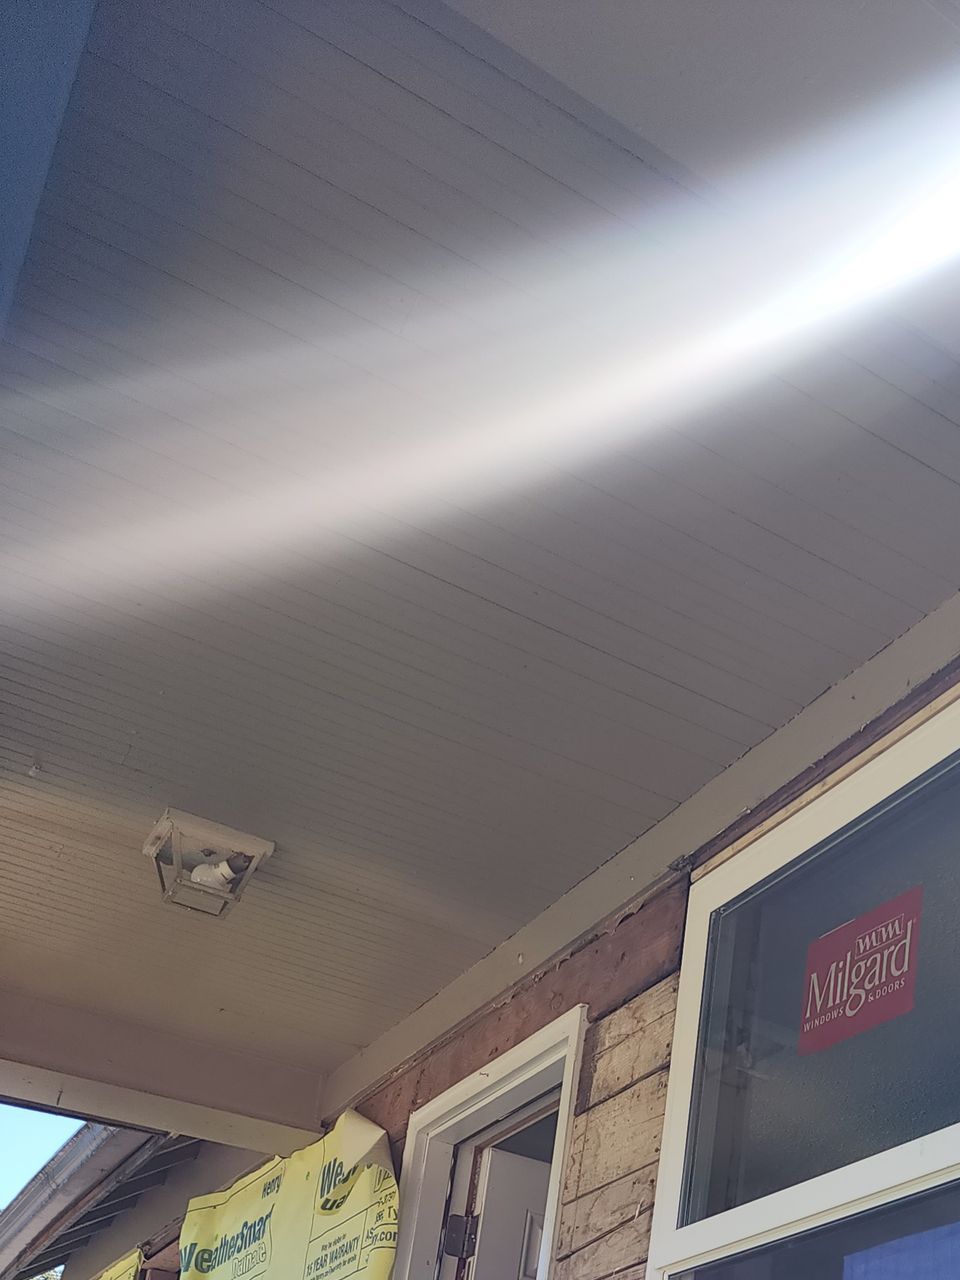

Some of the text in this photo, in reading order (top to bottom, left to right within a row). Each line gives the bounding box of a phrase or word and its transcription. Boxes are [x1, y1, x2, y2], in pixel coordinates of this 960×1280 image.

[805, 919, 913, 1017] Milgard
[803, 977, 905, 1033] WINDOWS & DOORS
[261, 1173, 282, 1200] Henry
